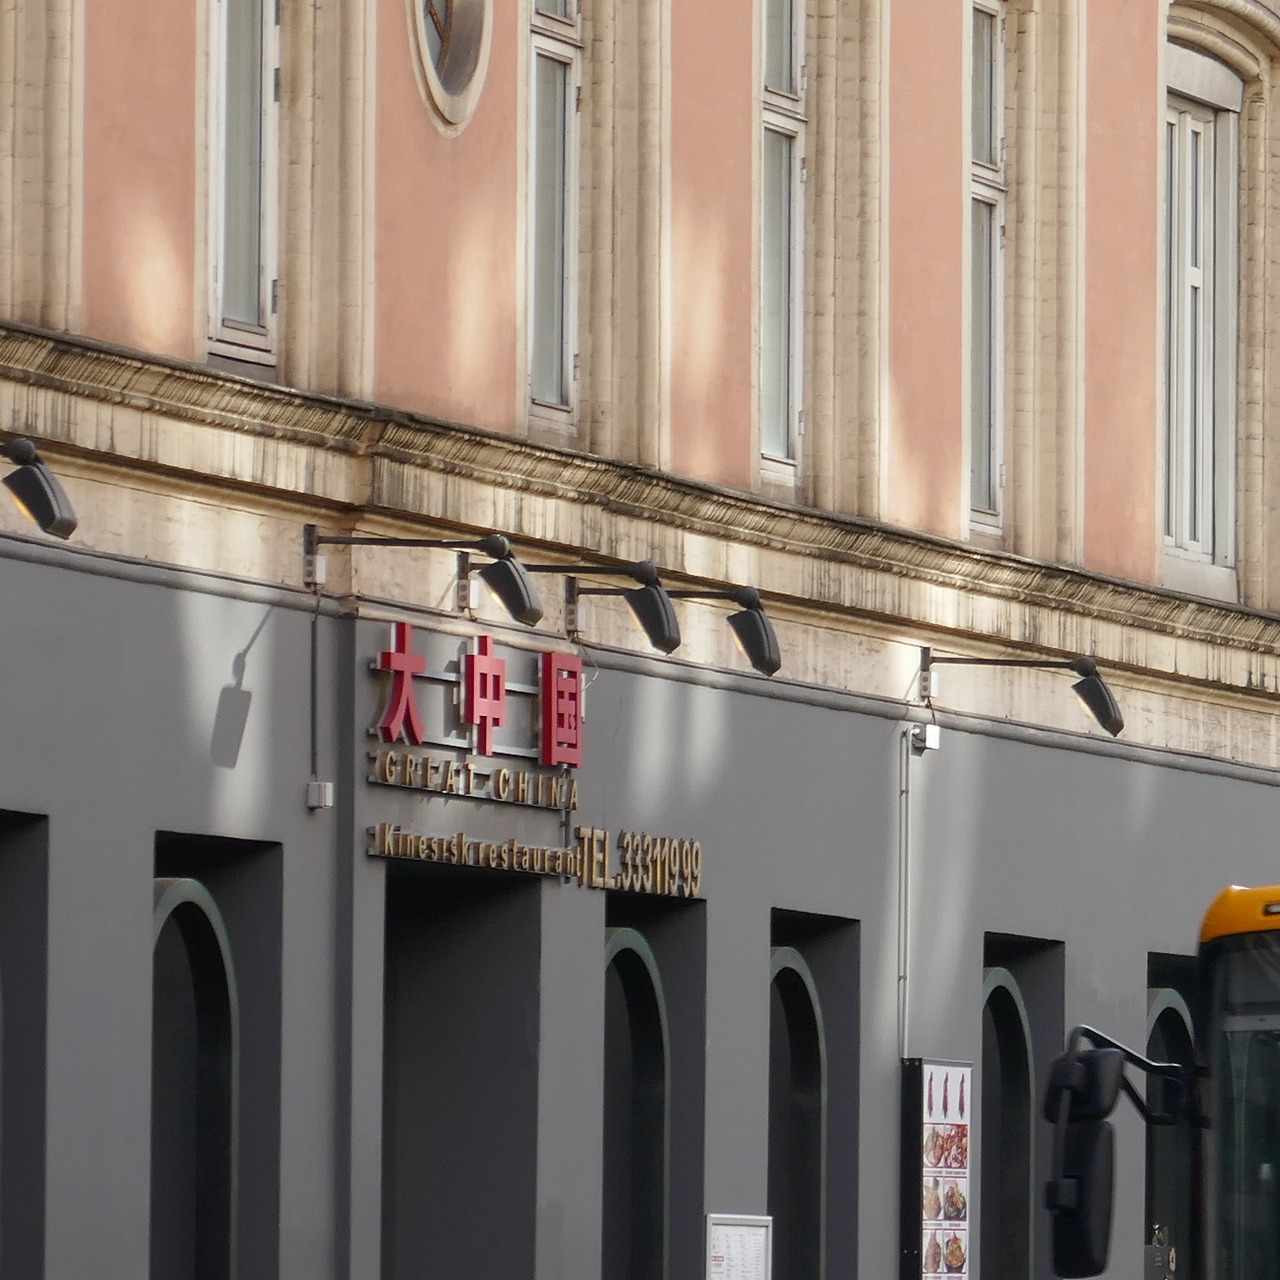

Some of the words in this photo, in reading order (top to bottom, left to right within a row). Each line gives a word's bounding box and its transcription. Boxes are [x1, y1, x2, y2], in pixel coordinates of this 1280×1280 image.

[382, 751, 476, 795] GREAT
[494, 768, 578, 810] CHINA
[383, 823, 470, 865] Kinesisk
[475, 839, 581, 877] restaurant
